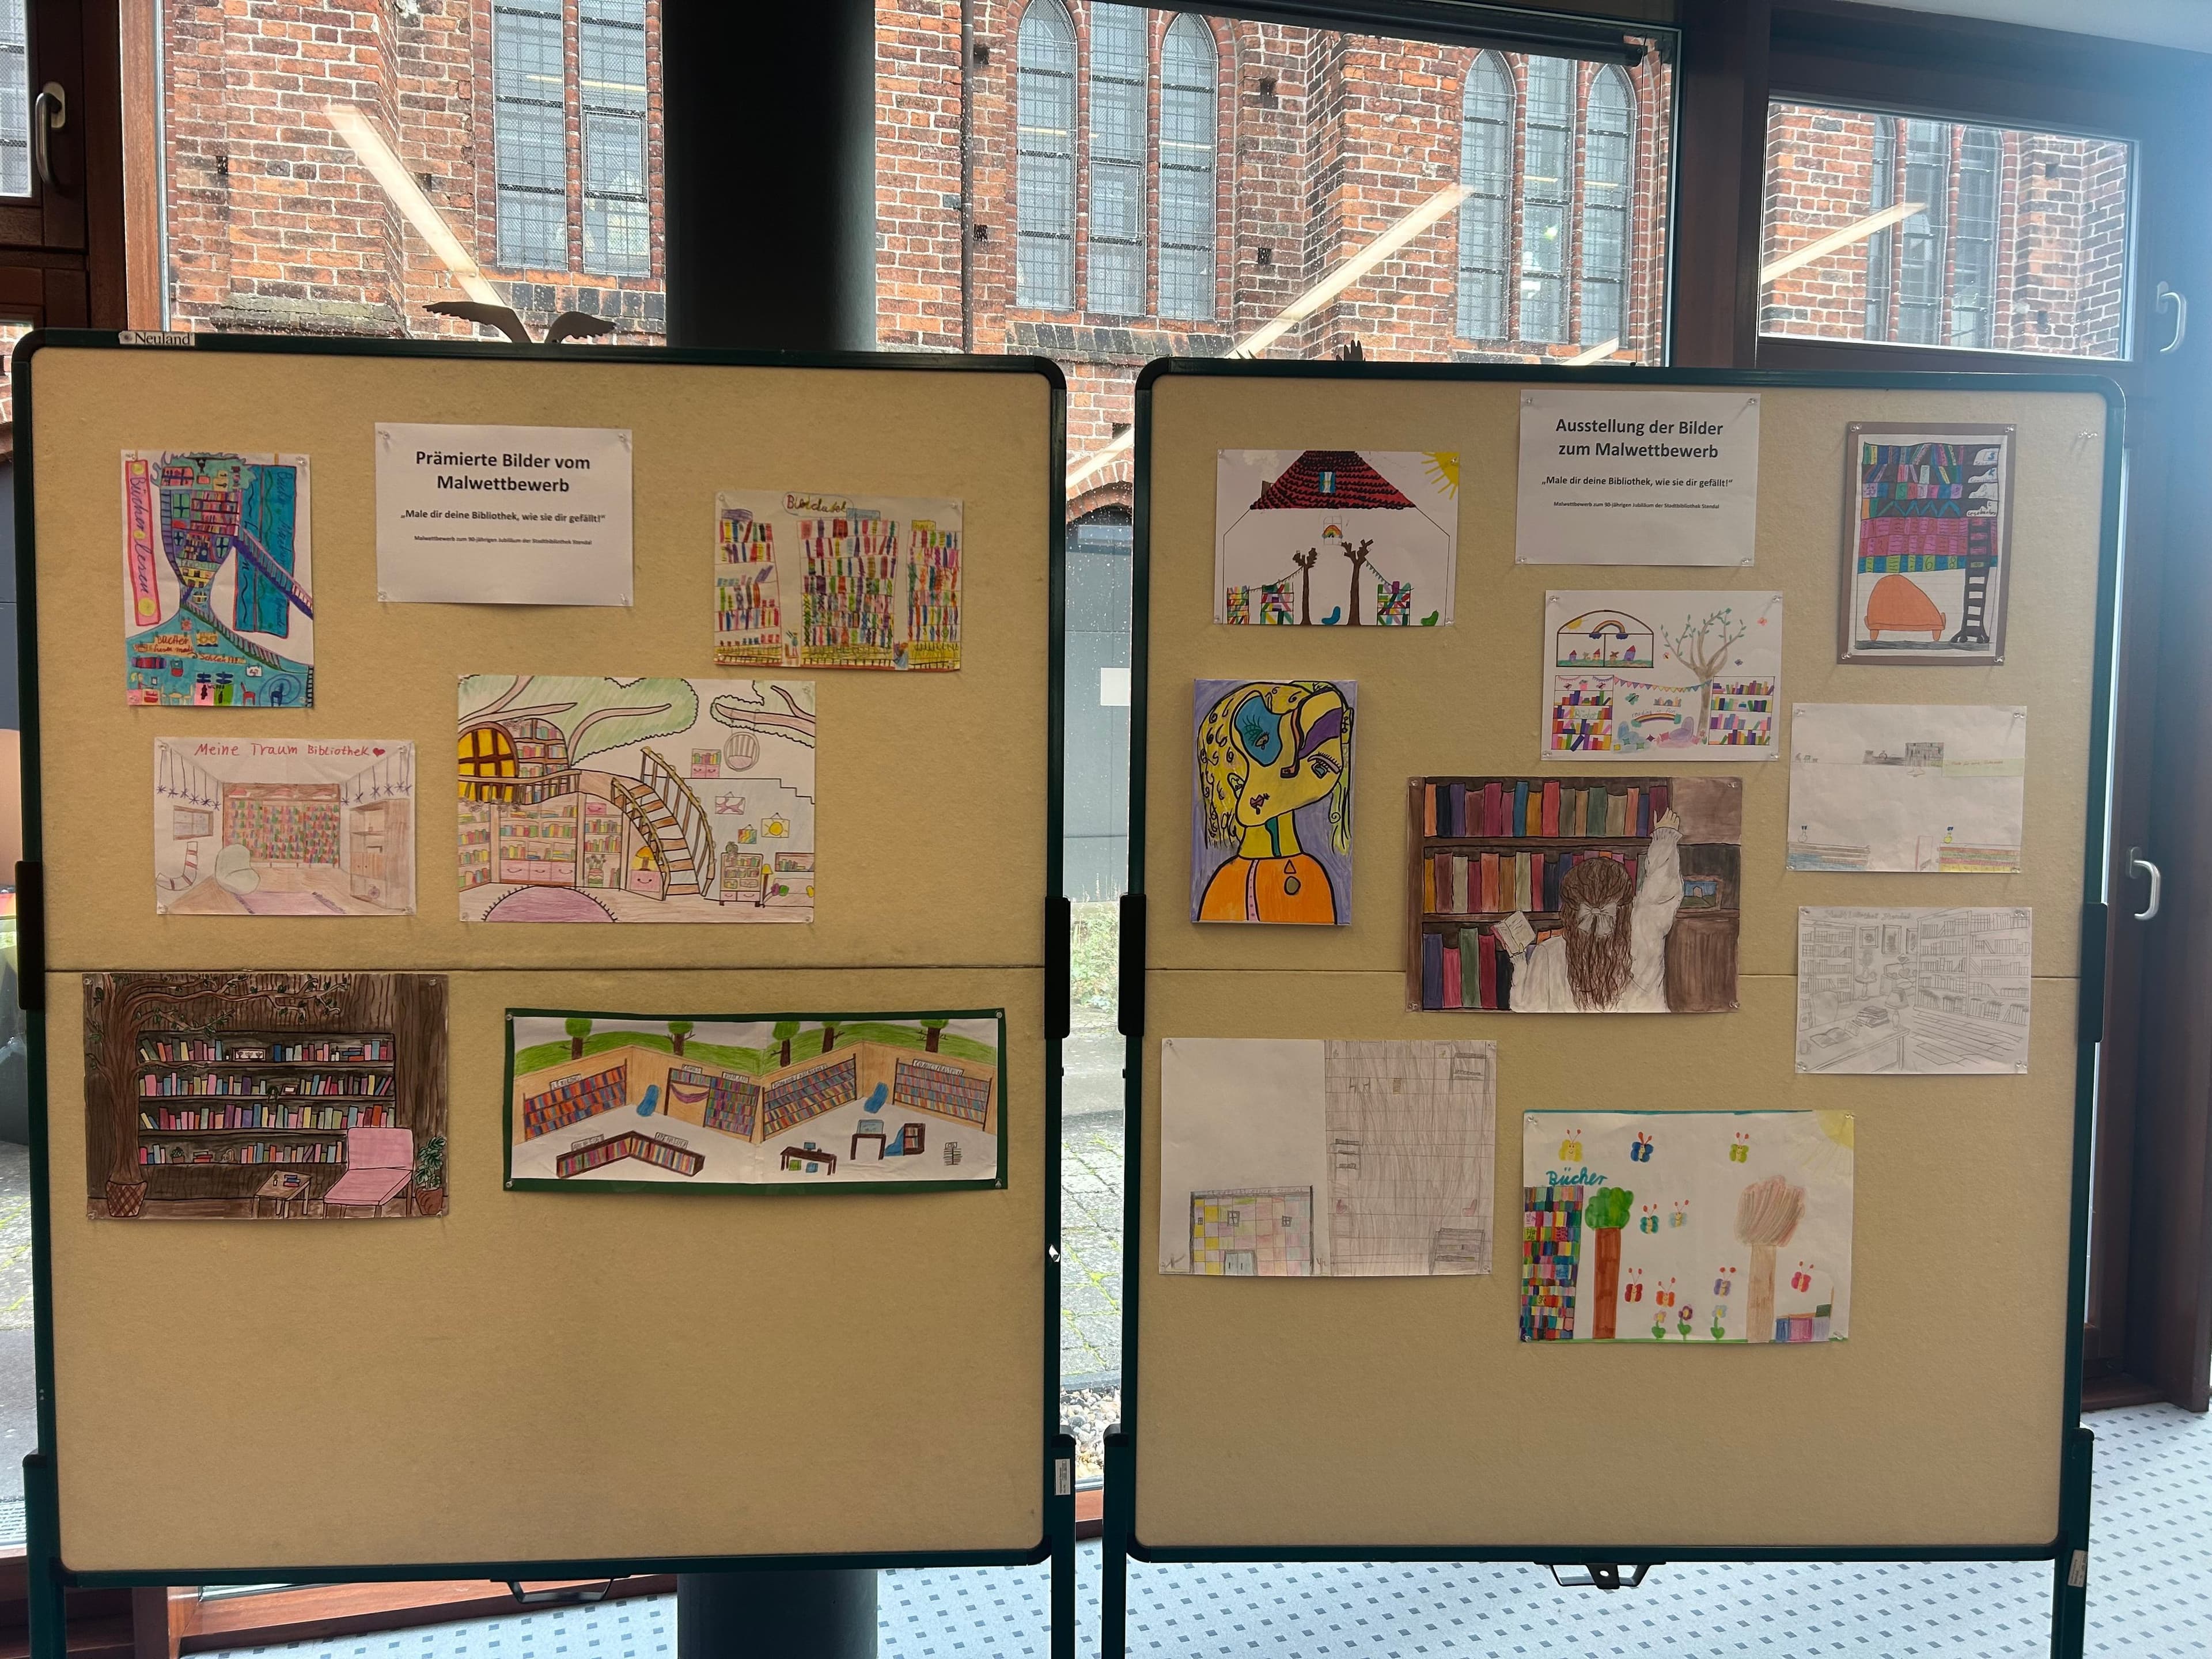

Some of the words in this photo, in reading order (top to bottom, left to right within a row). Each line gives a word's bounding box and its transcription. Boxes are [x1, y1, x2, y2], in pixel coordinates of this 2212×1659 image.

[135, 332, 190, 345] Neuland
[1556, 419, 1645, 436] Ausstellung
[1649, 420, 1674, 434] der
[1679, 421, 1723, 435] Bilder
[1559, 445, 1590, 455] zum
[1596, 442, 1718, 458] Malwettbewerb
[416, 451, 497, 467] Prämierte
[503, 454, 550, 468] Bilder
[555, 457, 590, 469] vom
[437, 475, 569, 492] Malwettbewerb
[1541, 476, 1567, 485] „Male
[1570, 476, 1581, 484] dir
[1608, 477, 1653, 487] Bibliothek,
[1672, 478, 1684, 486] sie
[400, 510, 428, 518] „Male
[430, 510, 442, 518] dir
[445, 510, 469, 519] deine
[472, 511, 519, 521] Bibliothek,
[522, 512, 539, 521] wie
[540, 513, 553, 521] sie
[555, 513, 567, 521] dir
[194, 743, 240, 756] Meine
[251, 743, 298, 756] Traum
[1546, 1166, 1608, 1186] Bücher
